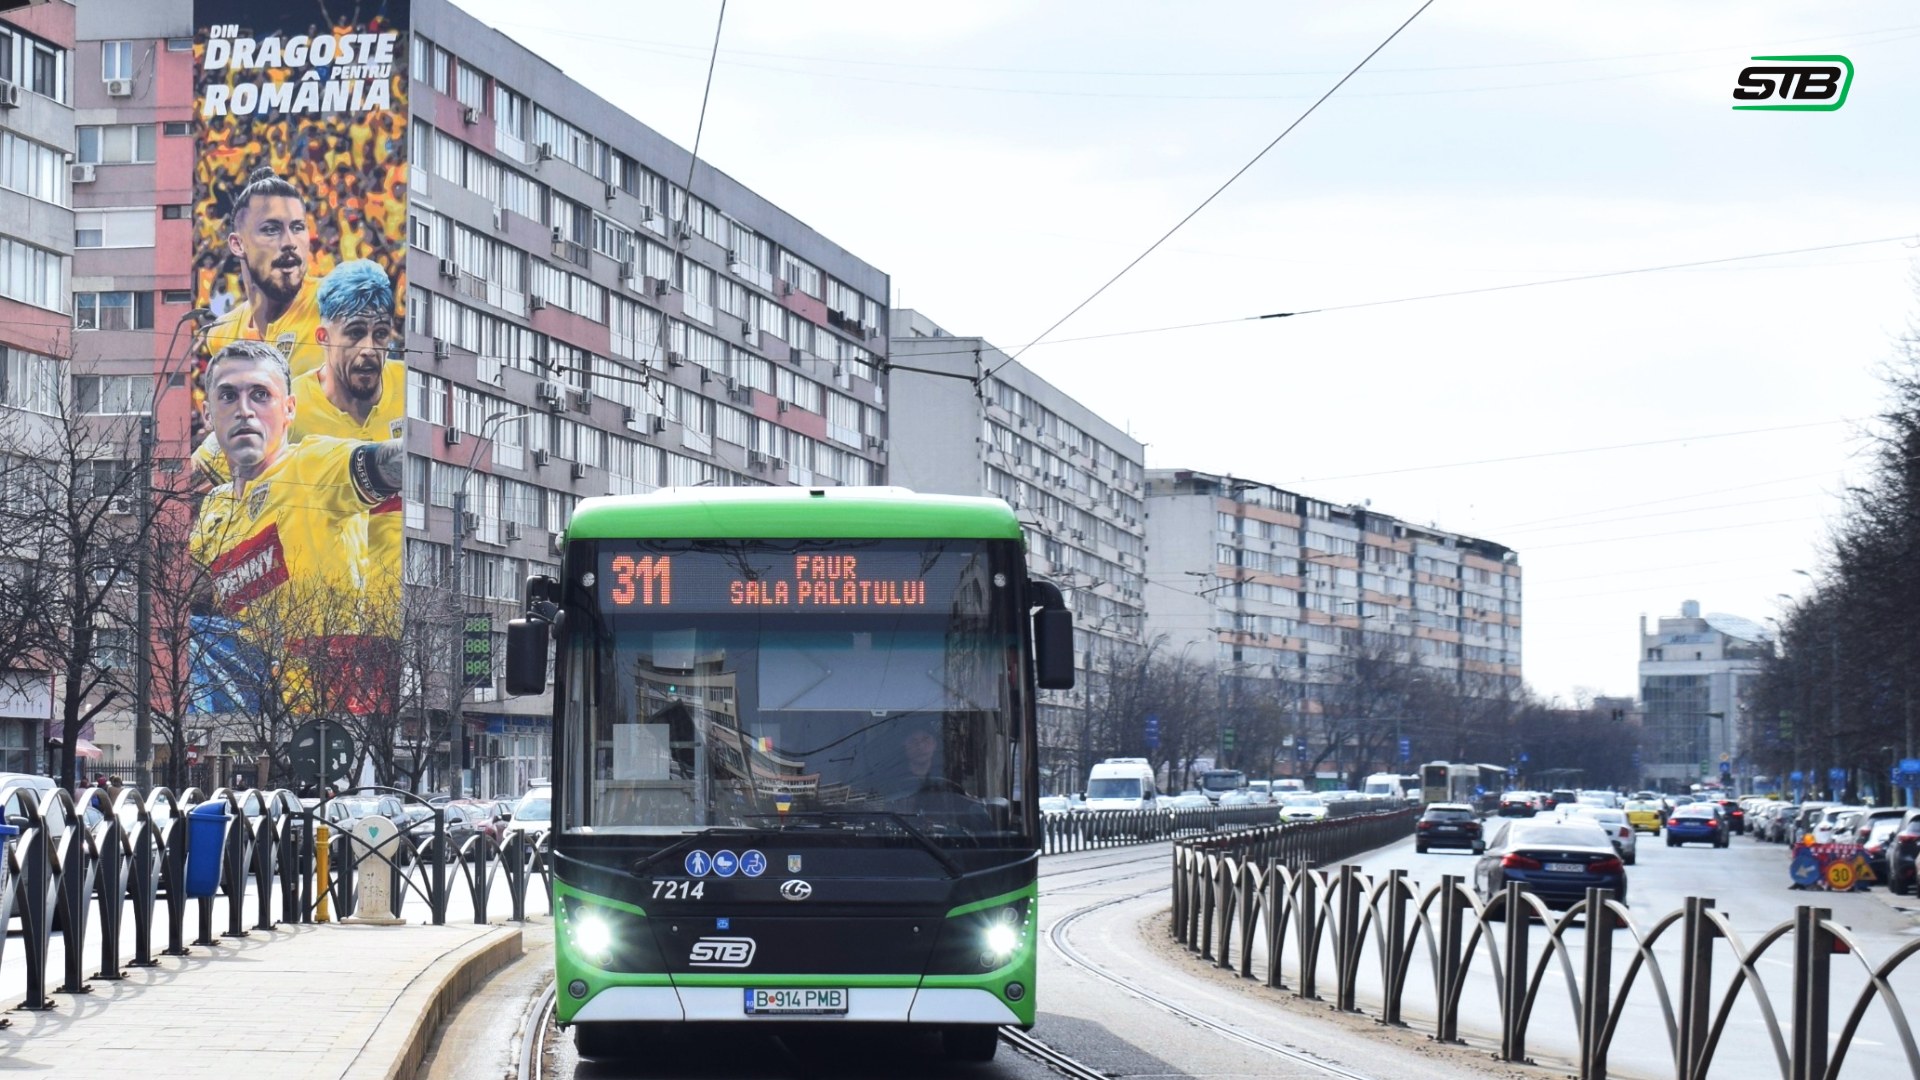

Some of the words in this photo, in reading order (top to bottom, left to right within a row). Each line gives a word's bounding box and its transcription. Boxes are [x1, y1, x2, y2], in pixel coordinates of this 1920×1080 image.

[210, 24, 239, 39] DIN
[204, 33, 397, 70] DRAGOSTE
[330, 64, 391, 80] PENTRU
[203, 70, 391, 116] ROMÂNIA
[213, 545, 275, 601] PENNY
[795, 555, 857, 579] FAUR
[612, 555, 671, 604] 311
[731, 581, 788, 604] SALA
[799, 581, 925, 604] PALATULUI
[1831, 868, 1850, 882] 30
[652, 881, 705, 899] 7214
[689, 942, 750, 961] STB
[757, 991, 769, 1007] B
[775, 991, 801, 1007] 914
[806, 991, 841, 1007] PMB
